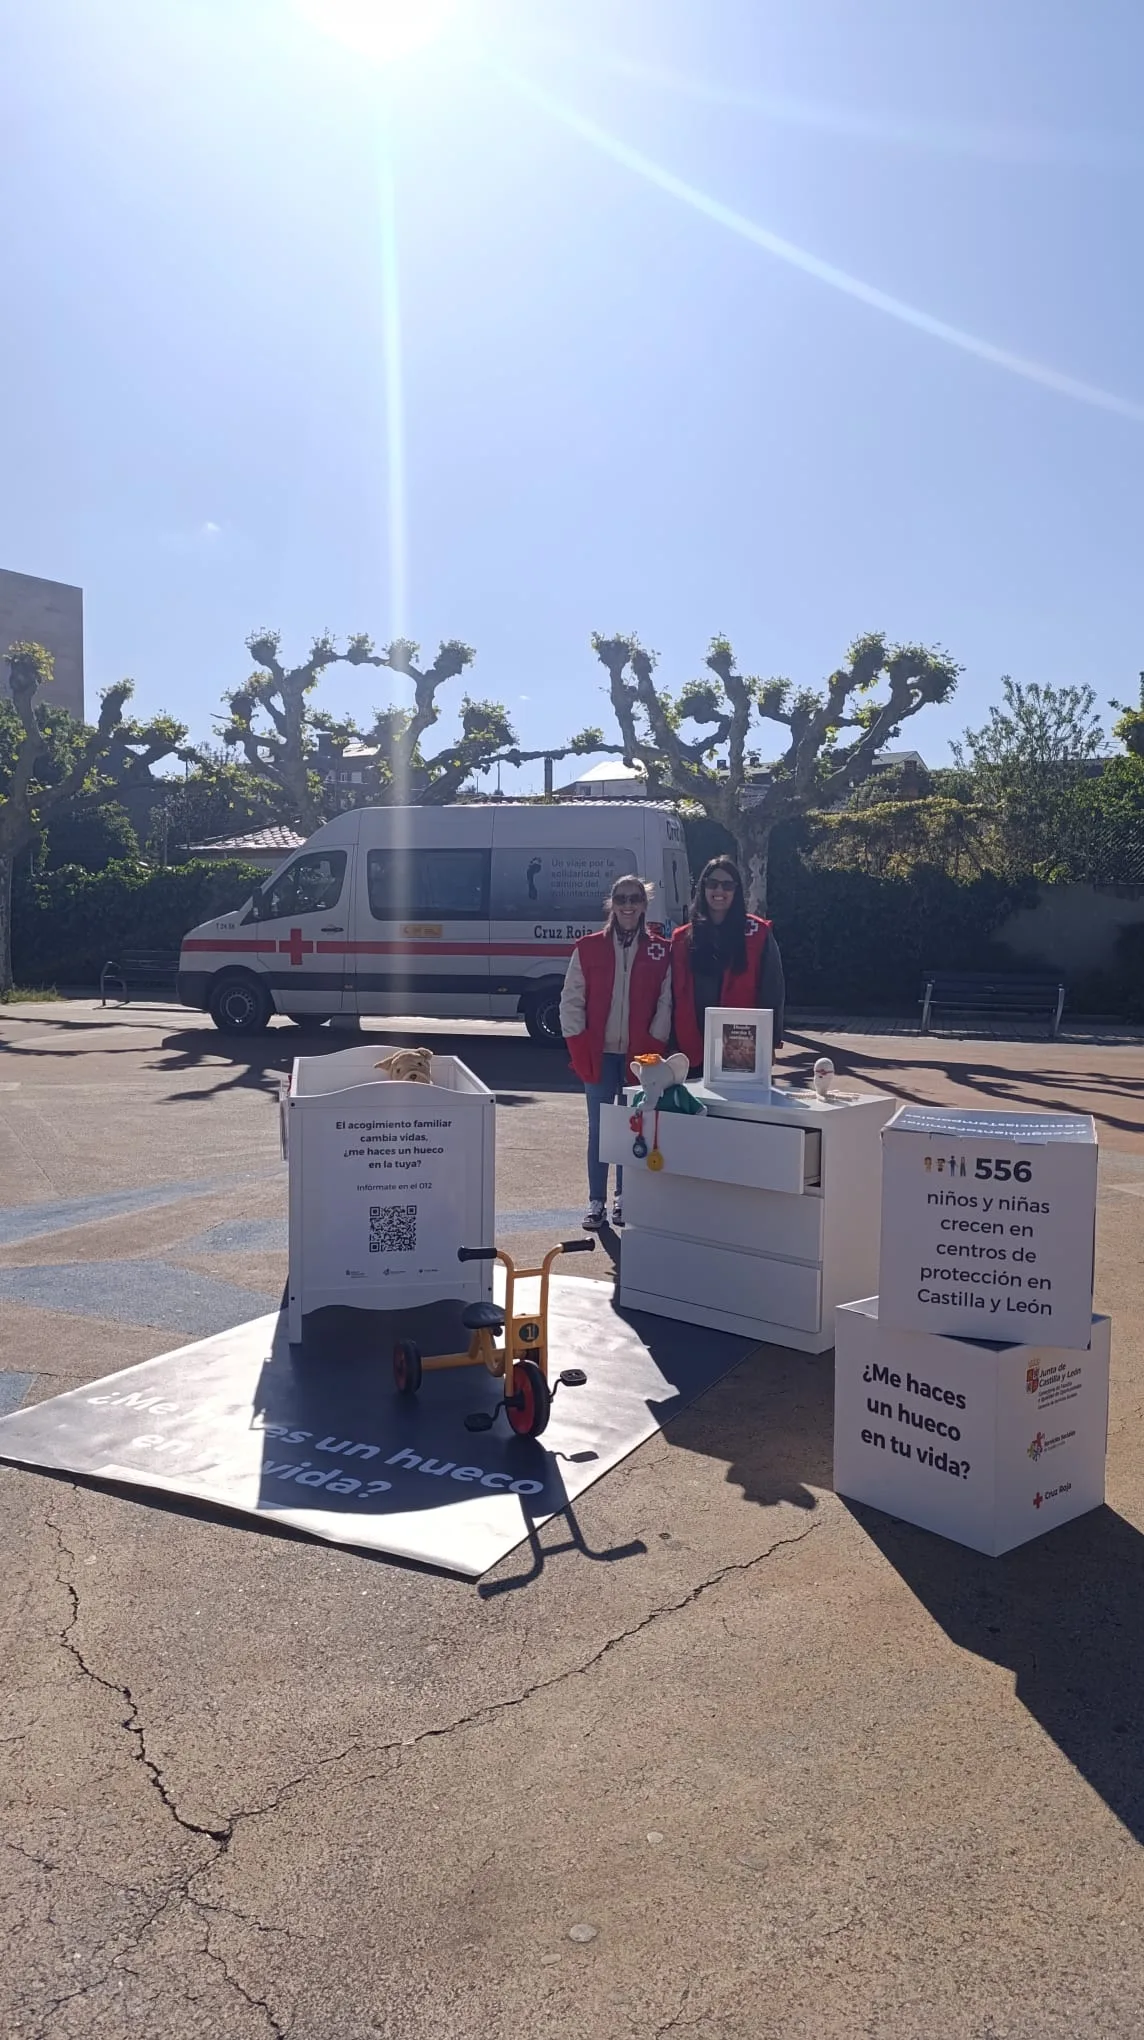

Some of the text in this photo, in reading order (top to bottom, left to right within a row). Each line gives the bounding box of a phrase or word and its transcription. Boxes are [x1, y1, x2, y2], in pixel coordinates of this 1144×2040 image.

[589, 860, 604, 869] por
[586, 880, 599, 888] del
[534, 925, 562, 939] Cruz
[335, 1119, 452, 1131] El acogimiento familiar
[360, 1133, 429, 1143] cambia vidas,
[343, 1148, 365, 1158] ¿me
[367, 1147, 396, 1156] haces
[413, 1146, 444, 1155] hueco
[368, 1160, 422, 1170] en la tuya?
[974, 1157, 1033, 1183] 556
[419, 1182, 433, 1190] 012
[927, 1190, 1050, 1214] niños y niñas
[940, 1218, 1034, 1237] crecen en
[936, 1242, 1037, 1263] centros de
[920, 1266, 1052, 1290] protección en
[917, 1288, 1052, 1316] Castilla y León
[1039, 1363, 1067, 1378] Junta de
[862, 1363, 967, 1410] ¿Me haces
[1039, 1375, 1061, 1387] Castilla
[867, 1397, 961, 1442] un hueco
[861, 1428, 971, 1480] en tu vida?
[131, 1434, 393, 1499] en vida?
[315, 1435, 544, 1495] un hueco
[1044, 1481, 1072, 1500] Cruz Roja
